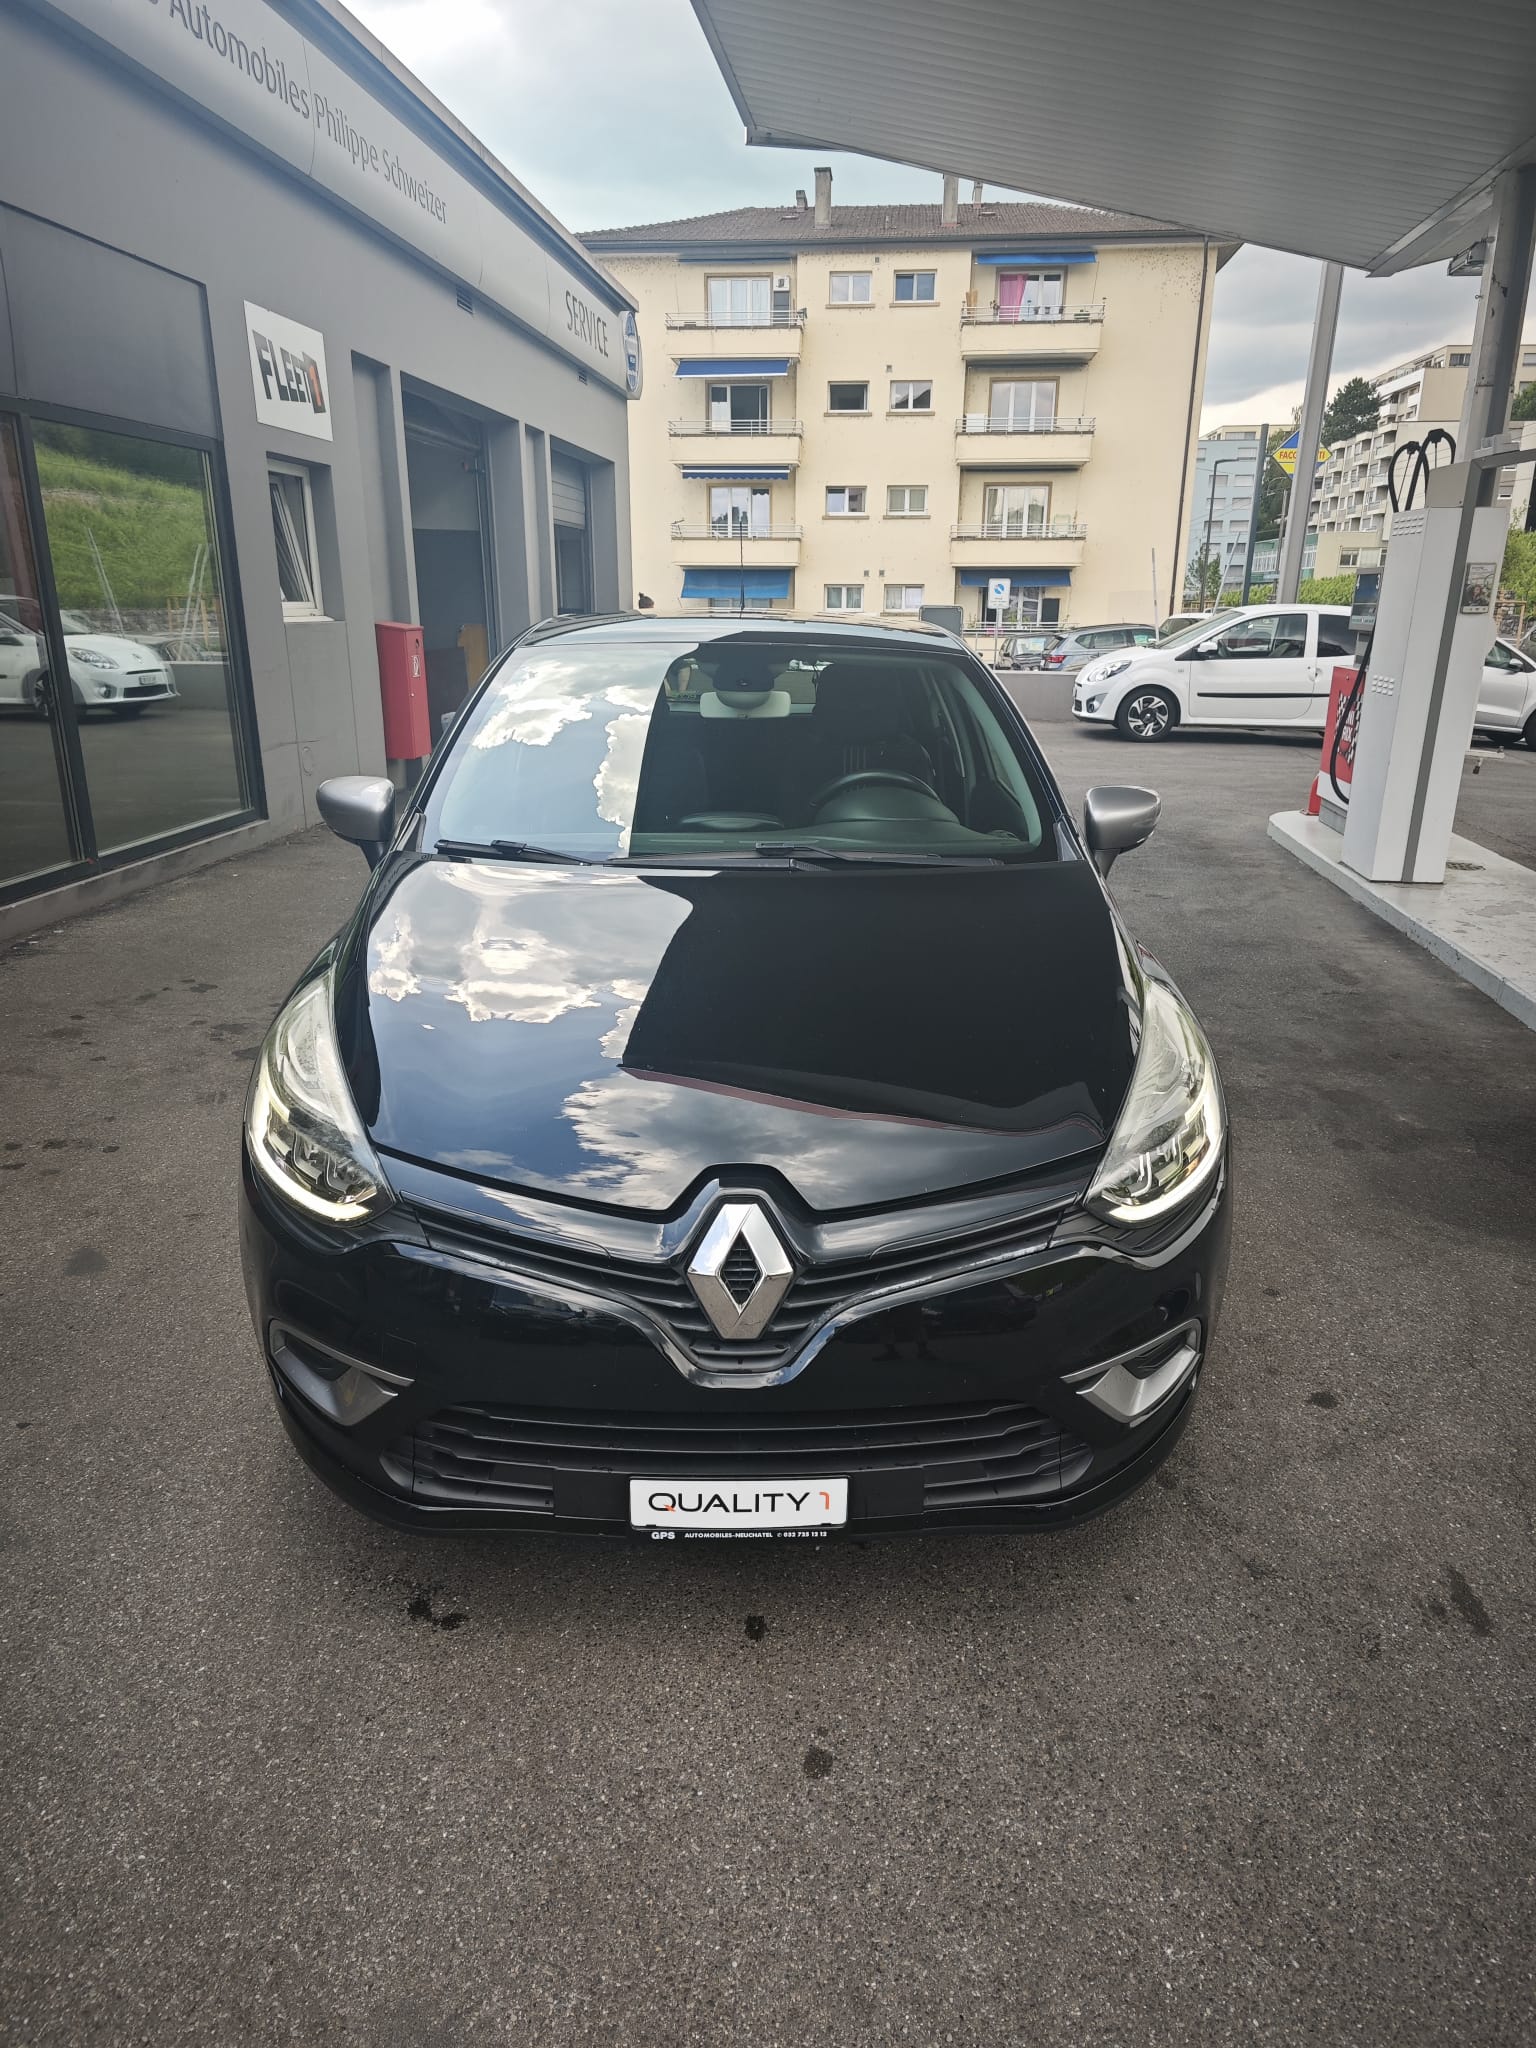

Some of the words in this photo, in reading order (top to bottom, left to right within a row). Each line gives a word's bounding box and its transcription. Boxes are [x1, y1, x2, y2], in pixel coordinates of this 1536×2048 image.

[169, 0, 310, 119] Automobiles
[314, 93, 379, 171] Philippe
[383, 148, 447, 224] Schweizer
[565, 289, 609, 358] SERVICE
[648, 1492, 810, 1513] QUALITY
[819, 1491, 830, 1510] 1
[651, 1531, 676, 1540] GPS
